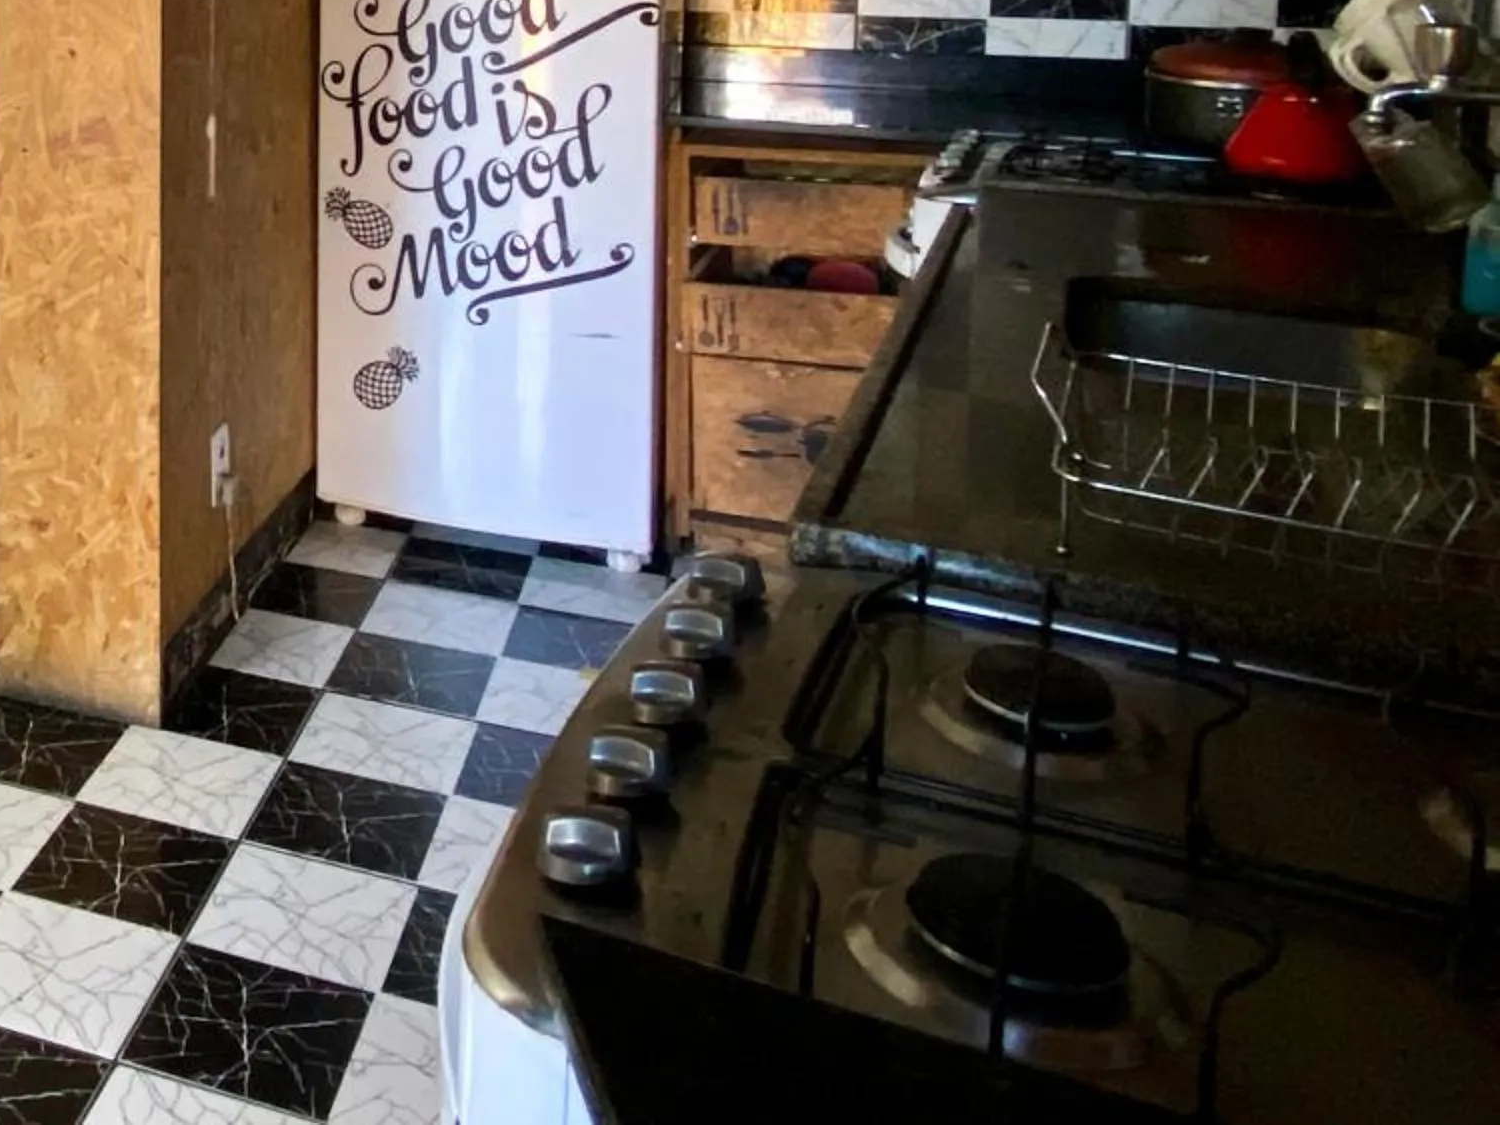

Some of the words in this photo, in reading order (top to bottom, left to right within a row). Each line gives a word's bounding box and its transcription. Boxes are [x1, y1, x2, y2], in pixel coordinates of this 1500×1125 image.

[321, 43, 478, 176] food
[491, 78, 558, 146] is
[387, 83, 613, 242] Good
[349, 196, 581, 316] Mood
